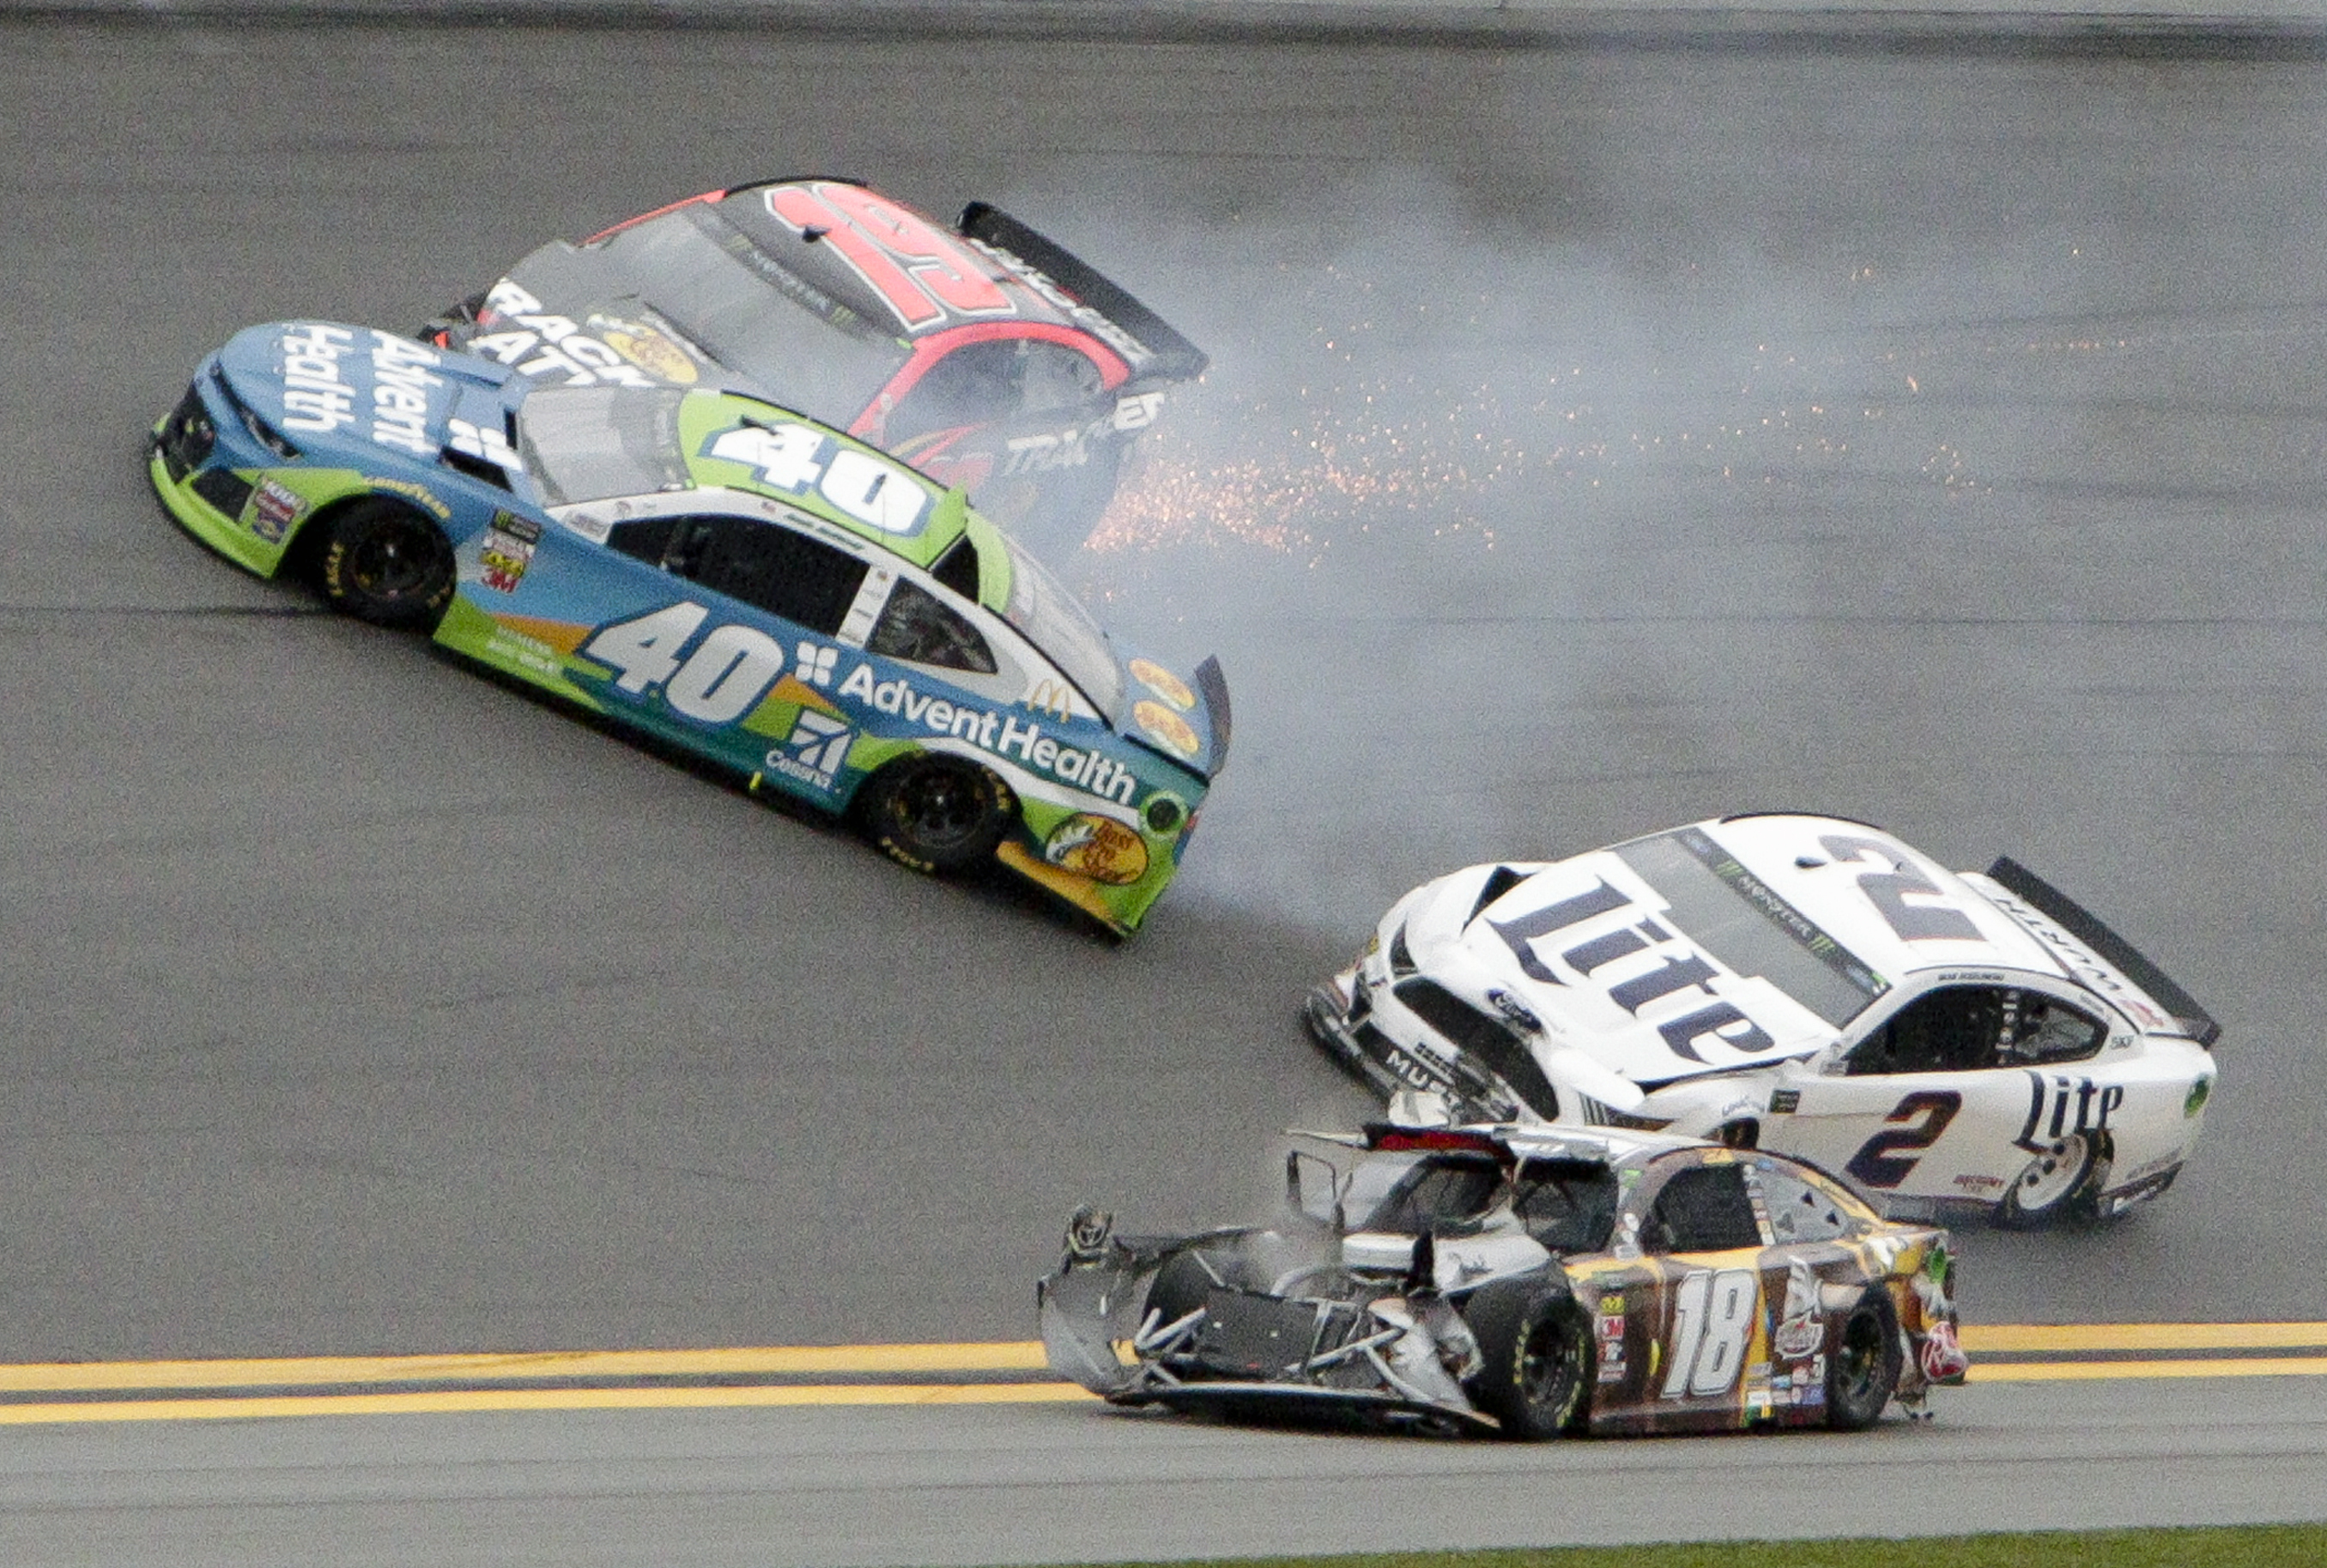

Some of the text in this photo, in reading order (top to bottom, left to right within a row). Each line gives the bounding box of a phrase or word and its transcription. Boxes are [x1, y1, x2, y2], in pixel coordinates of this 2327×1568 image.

[765, 181, 1017, 333] 19
[282, 324, 356, 432] Health
[696, 420, 937, 538] 40
[582, 601, 785, 726] 40
[838, 663, 1137, 807] AdventHealth
[1818, 835, 1988, 942] 2
[1483, 874, 1776, 1065] Lite
[1845, 1090, 1962, 1188] 2
[2011, 1069, 2124, 1155] Lite
[1660, 1268, 1760, 1400] 18
